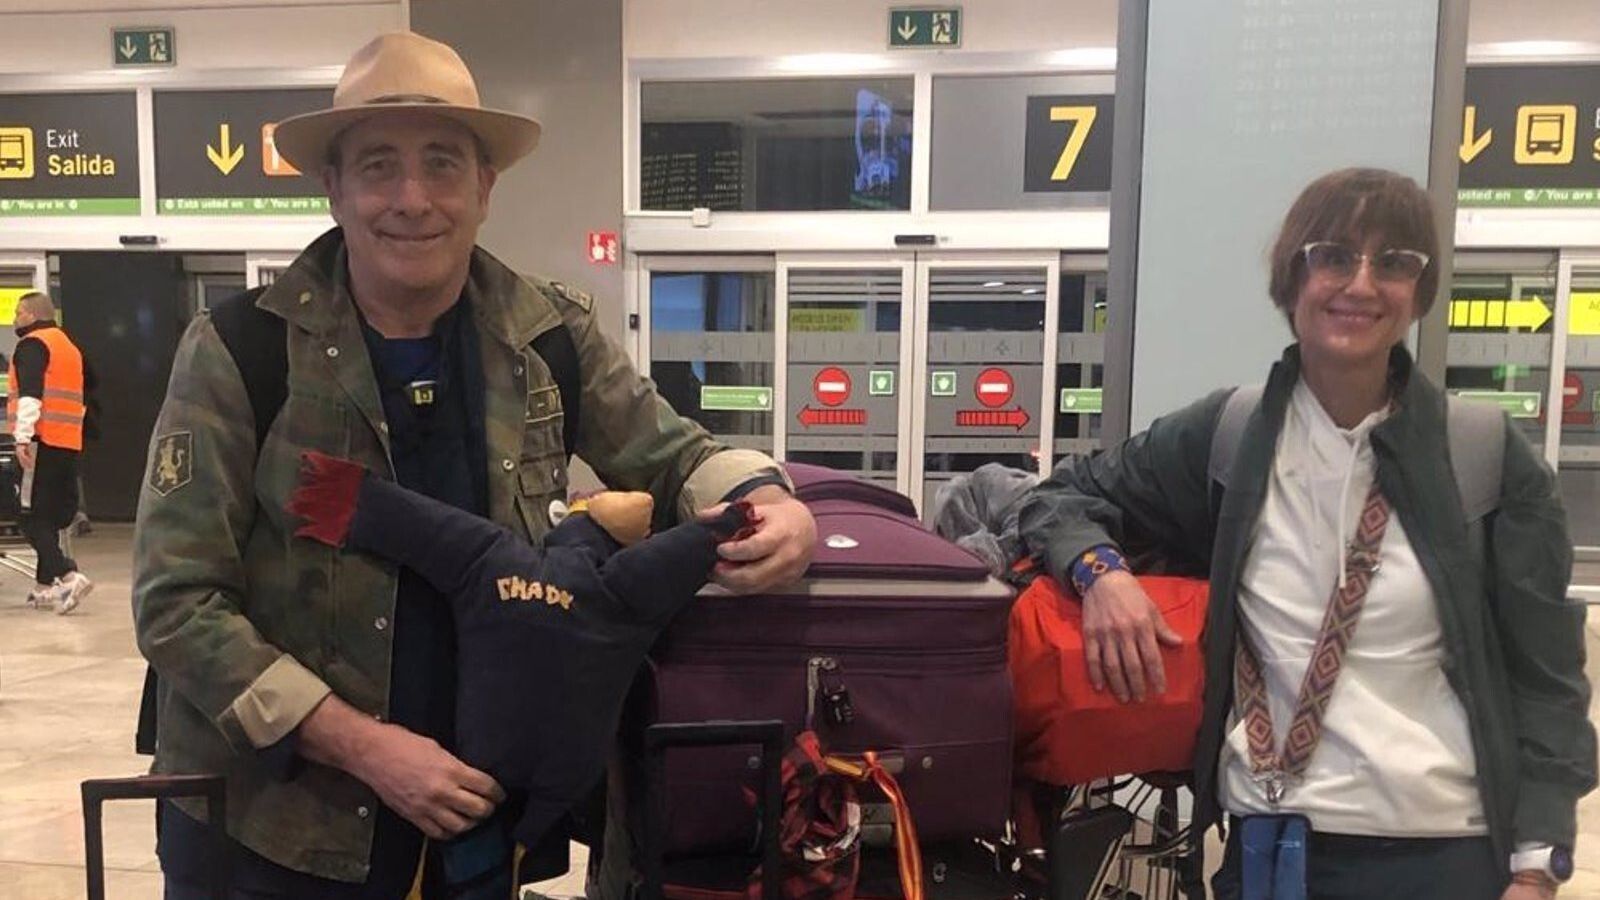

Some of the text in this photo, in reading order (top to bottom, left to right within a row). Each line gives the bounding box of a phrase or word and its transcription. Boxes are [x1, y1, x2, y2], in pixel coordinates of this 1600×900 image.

[46, 128, 79, 148] Exit
[1050, 105, 1097, 180] 7
[48, 153, 115, 176] Salida
[1547, 189, 1569, 200] You
[1572, 190, 1593, 200] are
[17, 199, 34, 209] You
[37, 201, 52, 209] are
[270, 198, 321, 209] You are in
